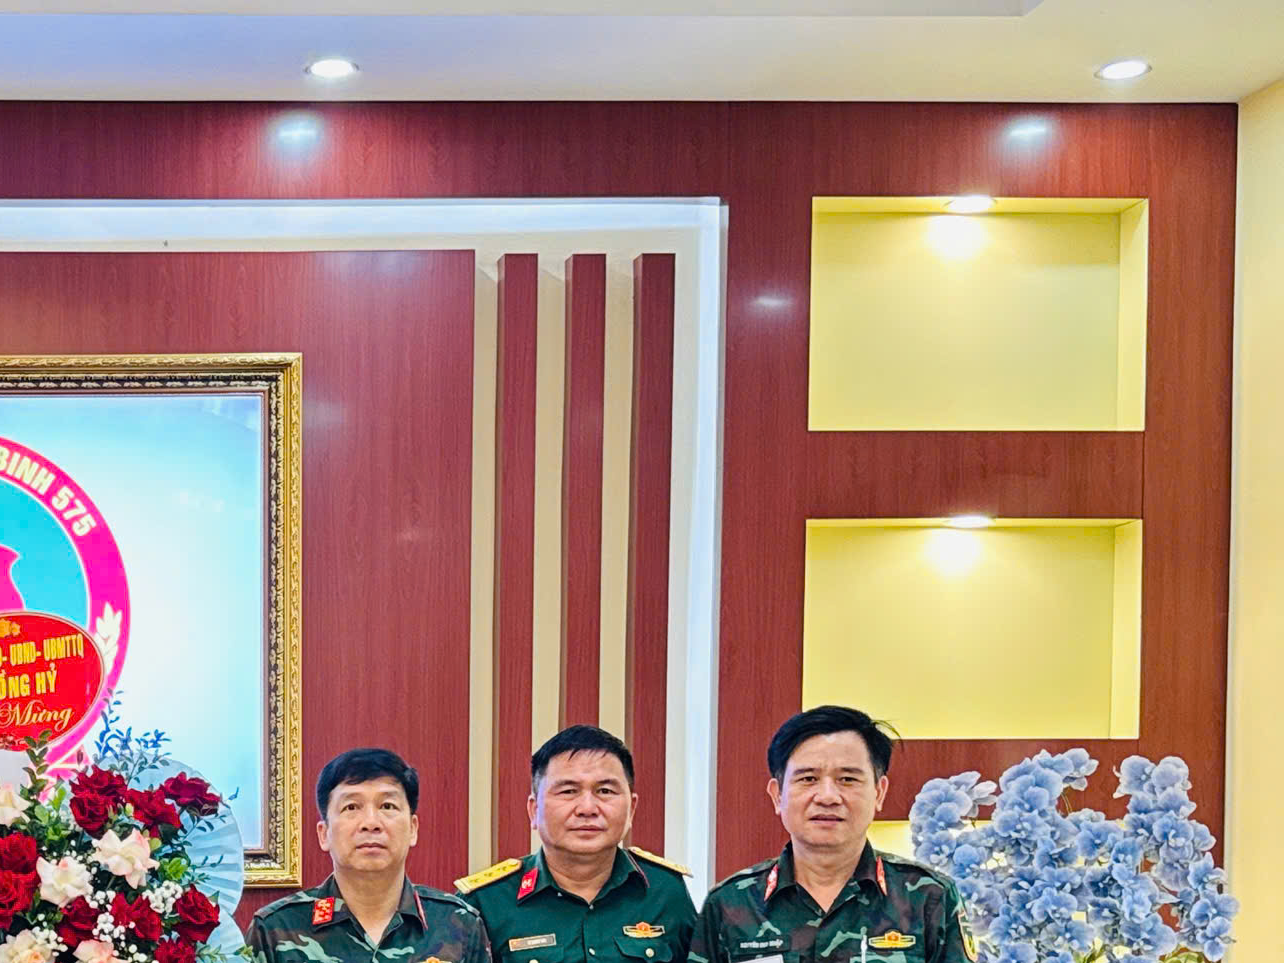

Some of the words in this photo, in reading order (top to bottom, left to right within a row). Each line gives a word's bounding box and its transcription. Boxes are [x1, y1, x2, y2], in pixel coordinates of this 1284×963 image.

[51, 485, 97, 537] 575
[43, 633, 85, 662] UBMTTQ
[35, 662, 57, 695] HỶ
